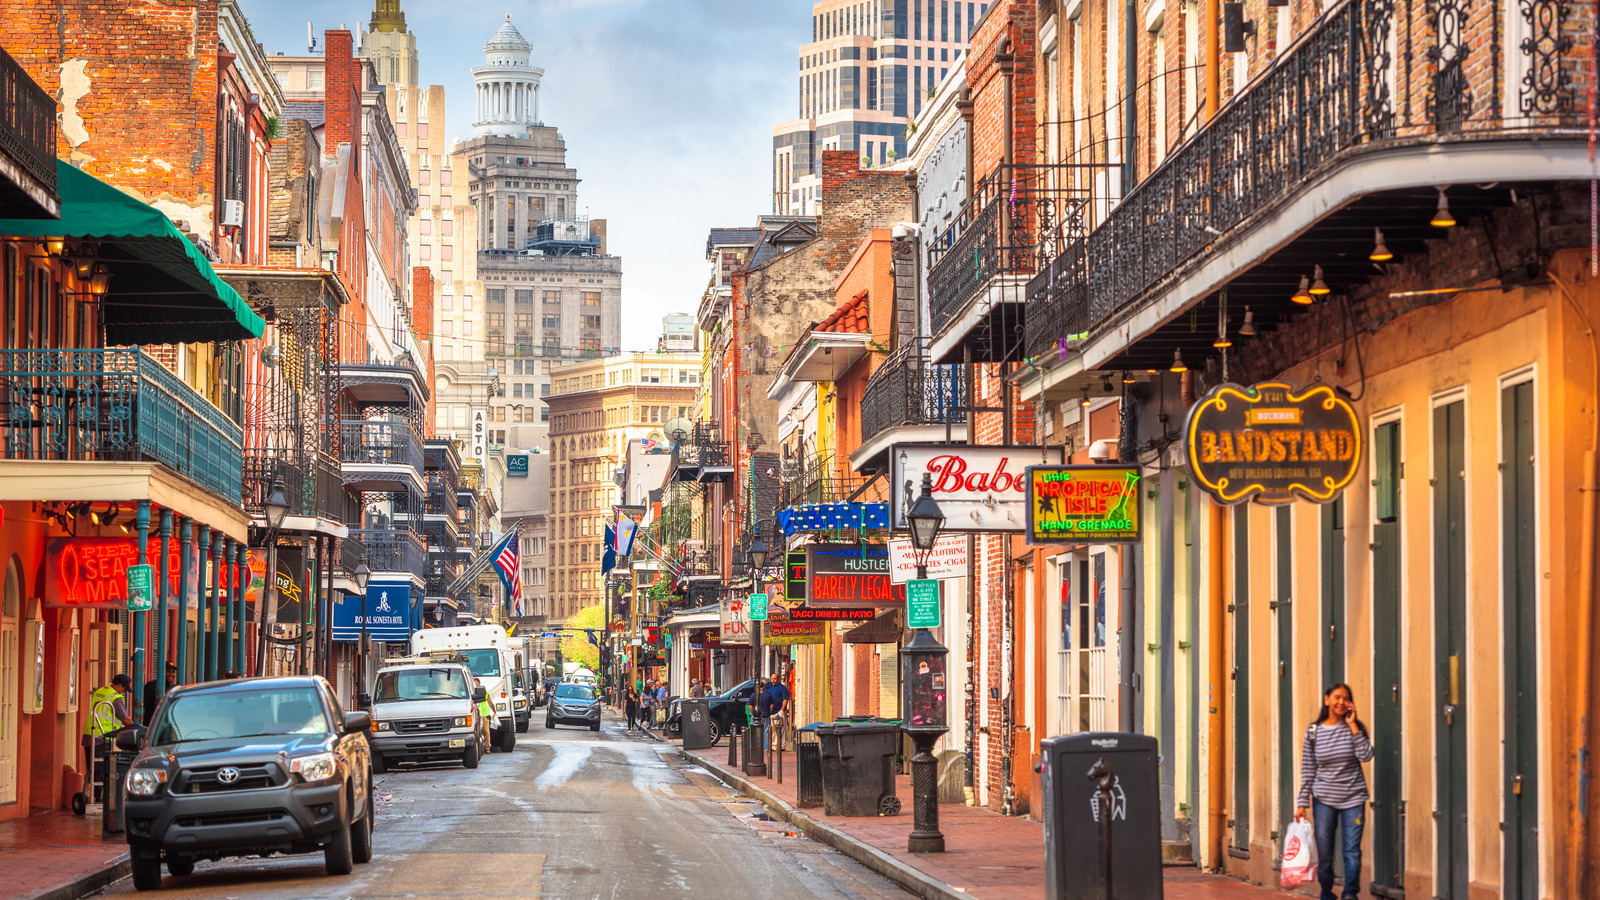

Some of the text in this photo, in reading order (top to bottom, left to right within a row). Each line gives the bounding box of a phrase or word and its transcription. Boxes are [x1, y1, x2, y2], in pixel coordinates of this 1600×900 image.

[1257, 412, 1295, 420] BOURBON
[1200, 429, 1354, 463] BANDSTAND
[509, 457, 526, 466] AC
[1042, 472, 1071, 482] Little
[1229, 469, 1243, 479] NEW
[1245, 469, 1273, 479] ORLEANS
[1309, 468, 1321, 478] USA
[1035, 480, 1135, 498] TROPICAL
[1065, 497, 1107, 514] ISLE
[1040, 520, 1131, 530] HAND GRENADE
[82, 544, 134, 559] PIER
[834, 549, 863, 557] LARRY
[931, 547, 965, 557] CLOTHING
[814, 575, 857, 600] BARELY
[860, 575, 896, 601] LEGAL
[791, 610, 815, 618] TACO
[815, 610, 841, 618] DINER
[842, 610, 848, 618] &
[849, 610, 874, 618] PATIO
[354, 616, 403, 624] ROAL SONESTA HOTEL
[771, 621, 819, 635] SHACK
